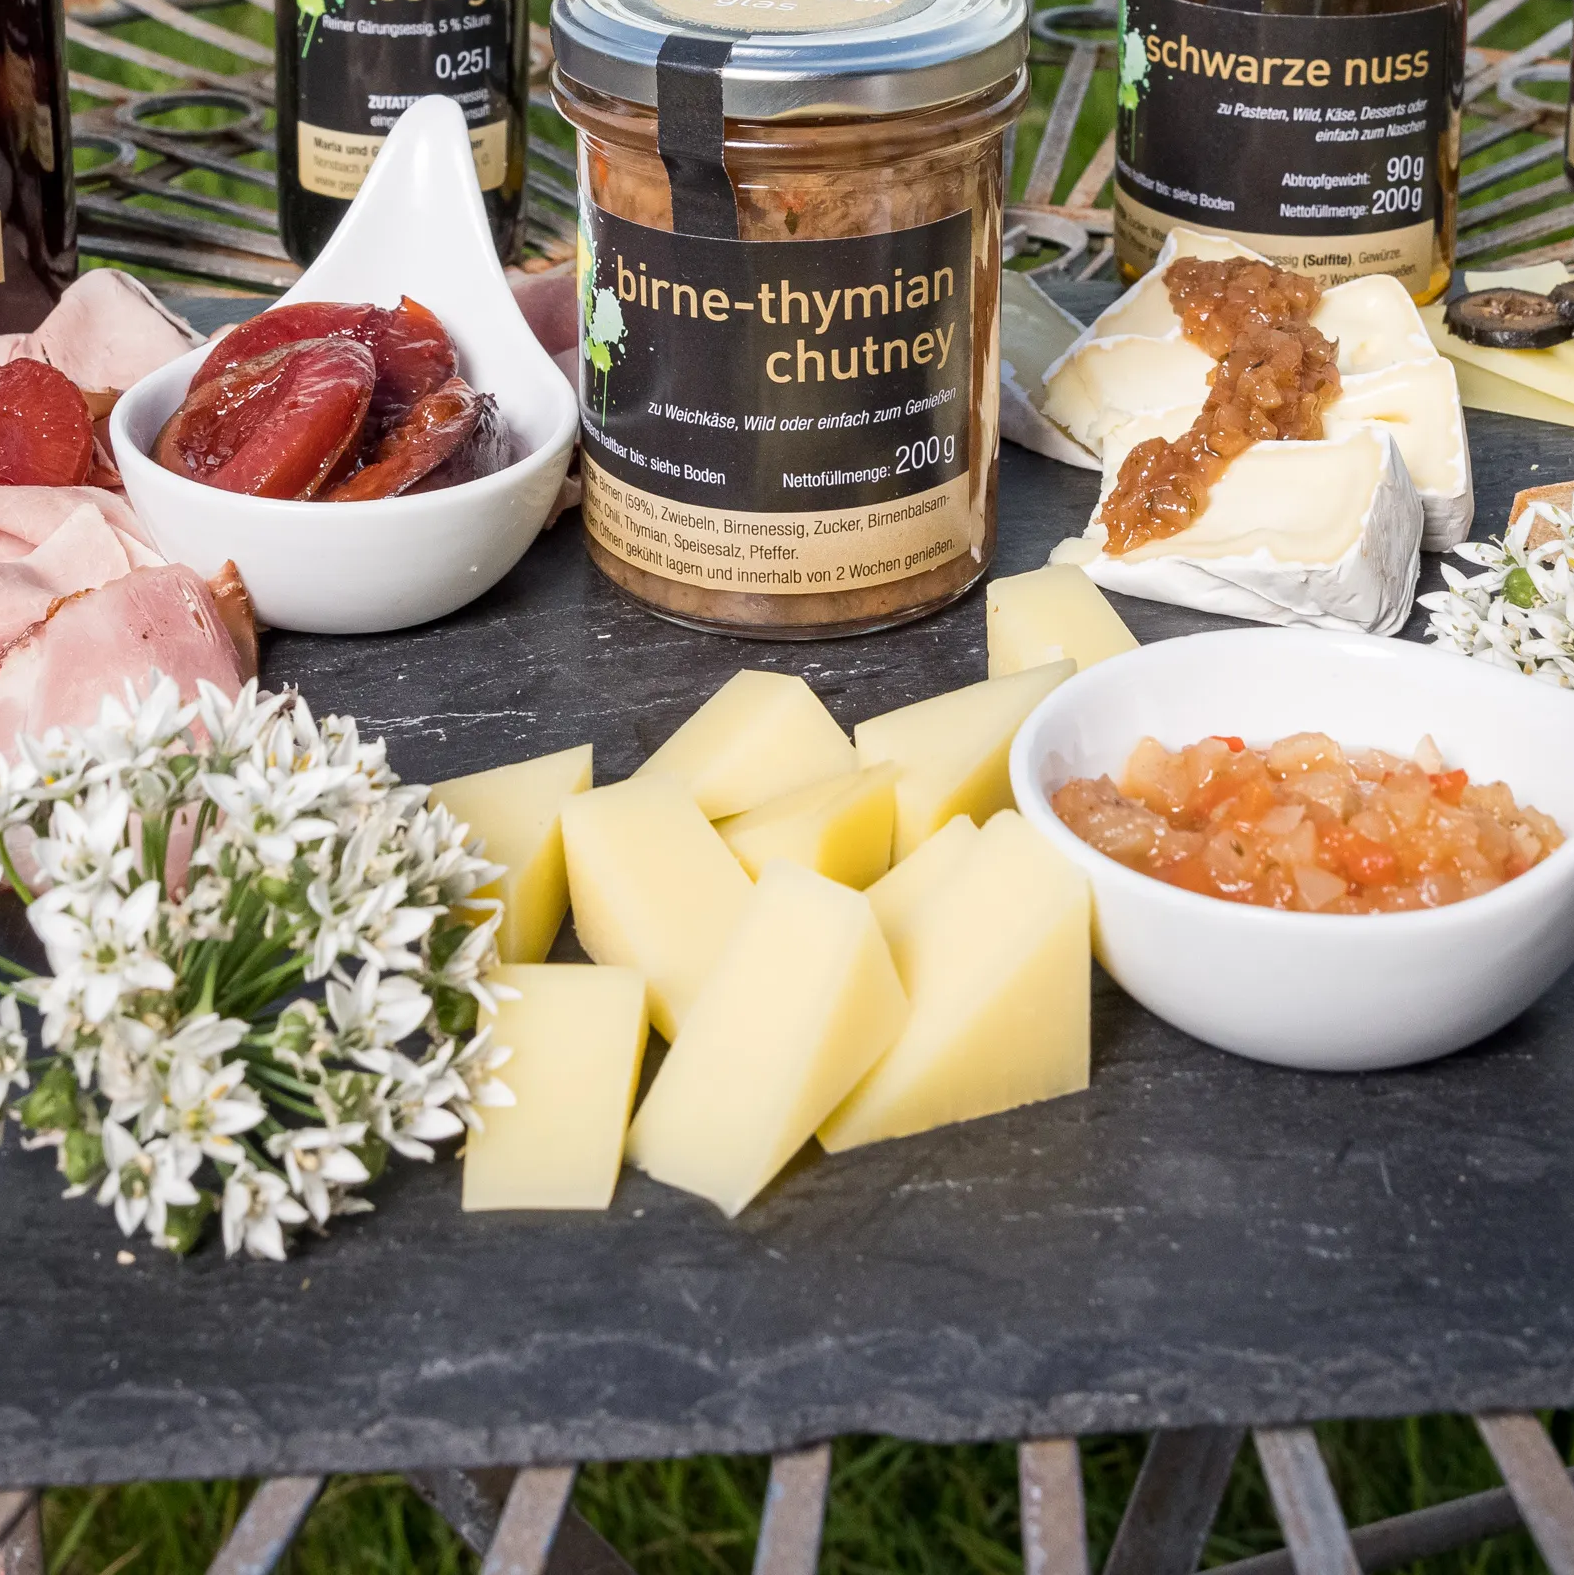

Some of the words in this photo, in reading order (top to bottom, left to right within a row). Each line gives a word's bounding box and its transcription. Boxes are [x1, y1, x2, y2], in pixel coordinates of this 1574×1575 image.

[322, 14, 355, 33] Reiner
[439, 19, 448, 34] 5
[450, 18, 462, 31] %
[1146, 34, 1331, 87] schwarze
[1344, 50, 1429, 87] nuss
[1217, 102, 1232, 115] zu
[1234, 103, 1289, 123] Pasteten,
[1293, 107, 1323, 123] Wild,
[1325, 106, 1357, 122] Käse,
[1360, 102, 1406, 121] Desserts
[1407, 98, 1428, 114] oder
[1315, 127, 1360, 143] einfach
[1360, 126, 1385, 141] zum
[1386, 119, 1427, 138] Naschen
[1199, 193, 1235, 212] Boden
[1281, 173, 1371, 190] Abtropfgewicht:
[1280, 203, 1369, 219] Nettofüllmenge:
[617, 254, 954, 335] birne-thymian
[766, 322, 955, 384] chutney
[648, 401, 662, 416] zu
[665, 403, 738, 432] Weichkäse,
[744, 415, 775, 431] Wild
[780, 416, 814, 431] oder
[817, 410, 869, 430] einfach
[873, 405, 901, 423] zum
[905, 386, 956, 416] Genießen
[601, 432, 627, 459] haltbar
[630, 447, 648, 468] bis:
[650, 457, 681, 477] siehe
[684, 464, 726, 485] Boden
[783, 465, 891, 488] Nettofüllmenge:
[599, 475, 623, 503] Birnen
[625, 492, 657, 520] (59%),
[661, 505, 719, 534] Zwiebeln,
[724, 518, 809, 539] Birnenessig,
[814, 518, 864, 536] Zucker,
[868, 493, 951, 529] Birnenbalsam-
[599, 521, 623, 550] Öffnen
[626, 540, 663, 567] gekühlt
[666, 554, 702, 577] lagern
[707, 568, 733, 581] und
[737, 568, 802, 584] innerhalb
[807, 571, 831, 584] von
[836, 567, 845, 580] 2
[849, 559, 901, 578] Wochen
[905, 537, 955, 570] genießen.
[604, 502, 623, 527] Chili,
[624, 514, 670, 547] Thymian,
[674, 533, 745, 560] Speisesalz,
[750, 545, 799, 560] Pfeffer.
